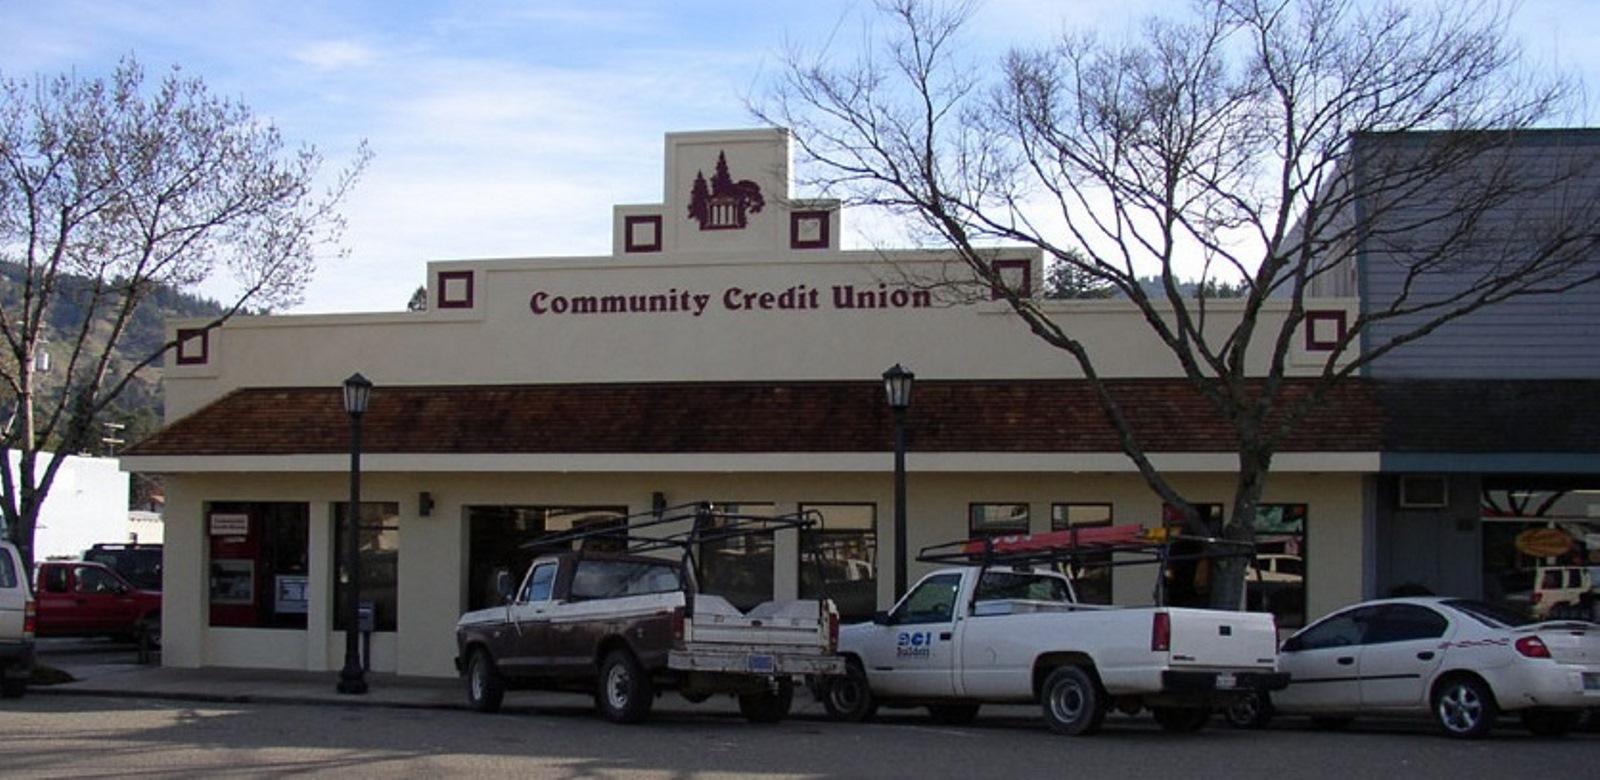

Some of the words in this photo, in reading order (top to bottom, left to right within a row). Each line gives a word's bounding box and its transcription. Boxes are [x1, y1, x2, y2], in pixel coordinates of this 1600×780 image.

[530, 288, 710, 316] Community
[723, 285, 819, 310] Credit
[832, 283, 932, 309] Union
